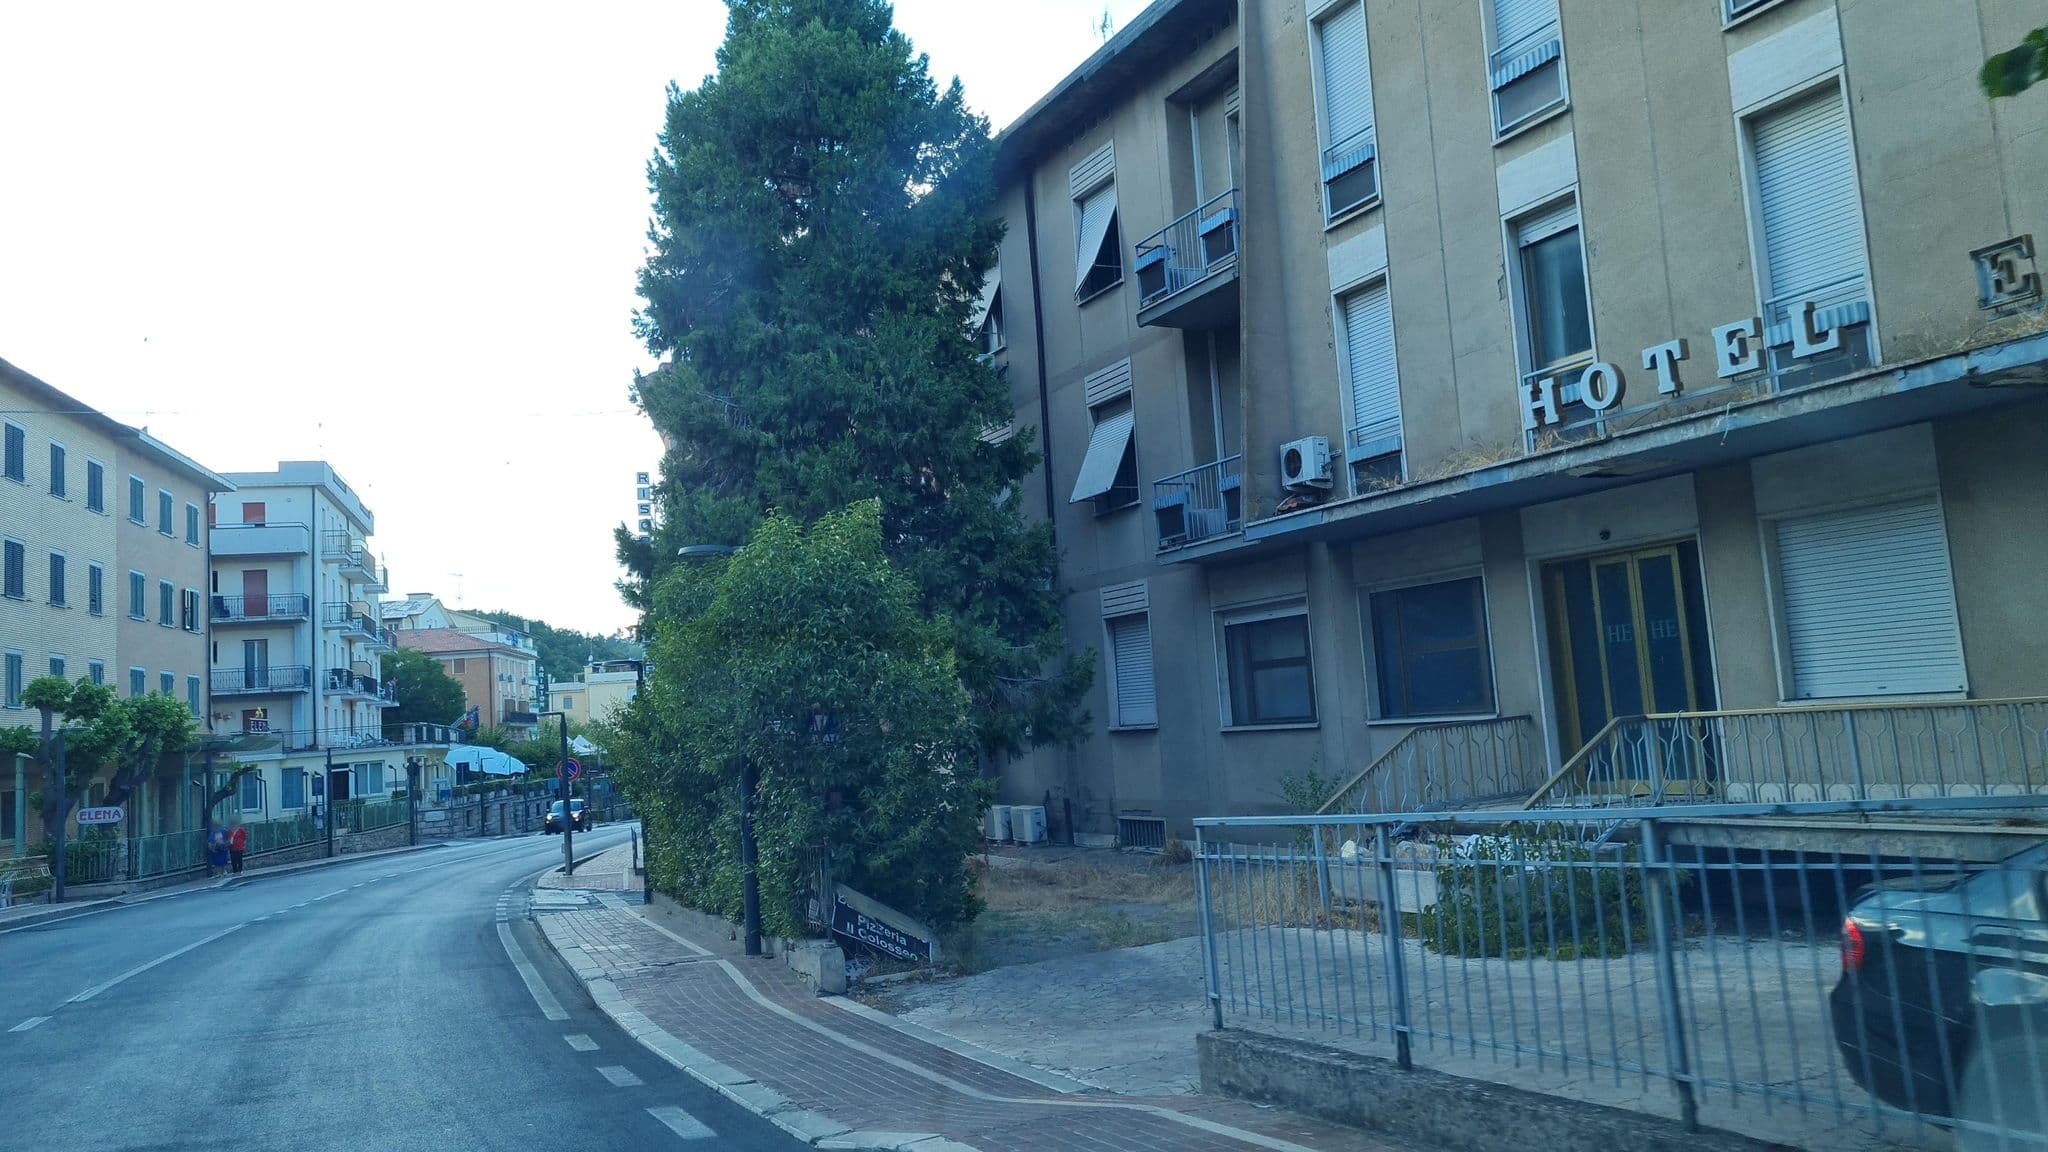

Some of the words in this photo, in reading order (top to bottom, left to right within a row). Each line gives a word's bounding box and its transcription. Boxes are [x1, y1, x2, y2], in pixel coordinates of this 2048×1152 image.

[1522, 301, 1847, 430] HOTEL
[79, 809, 121, 820] ELENA
[857, 914, 908, 946] Pizzeria
